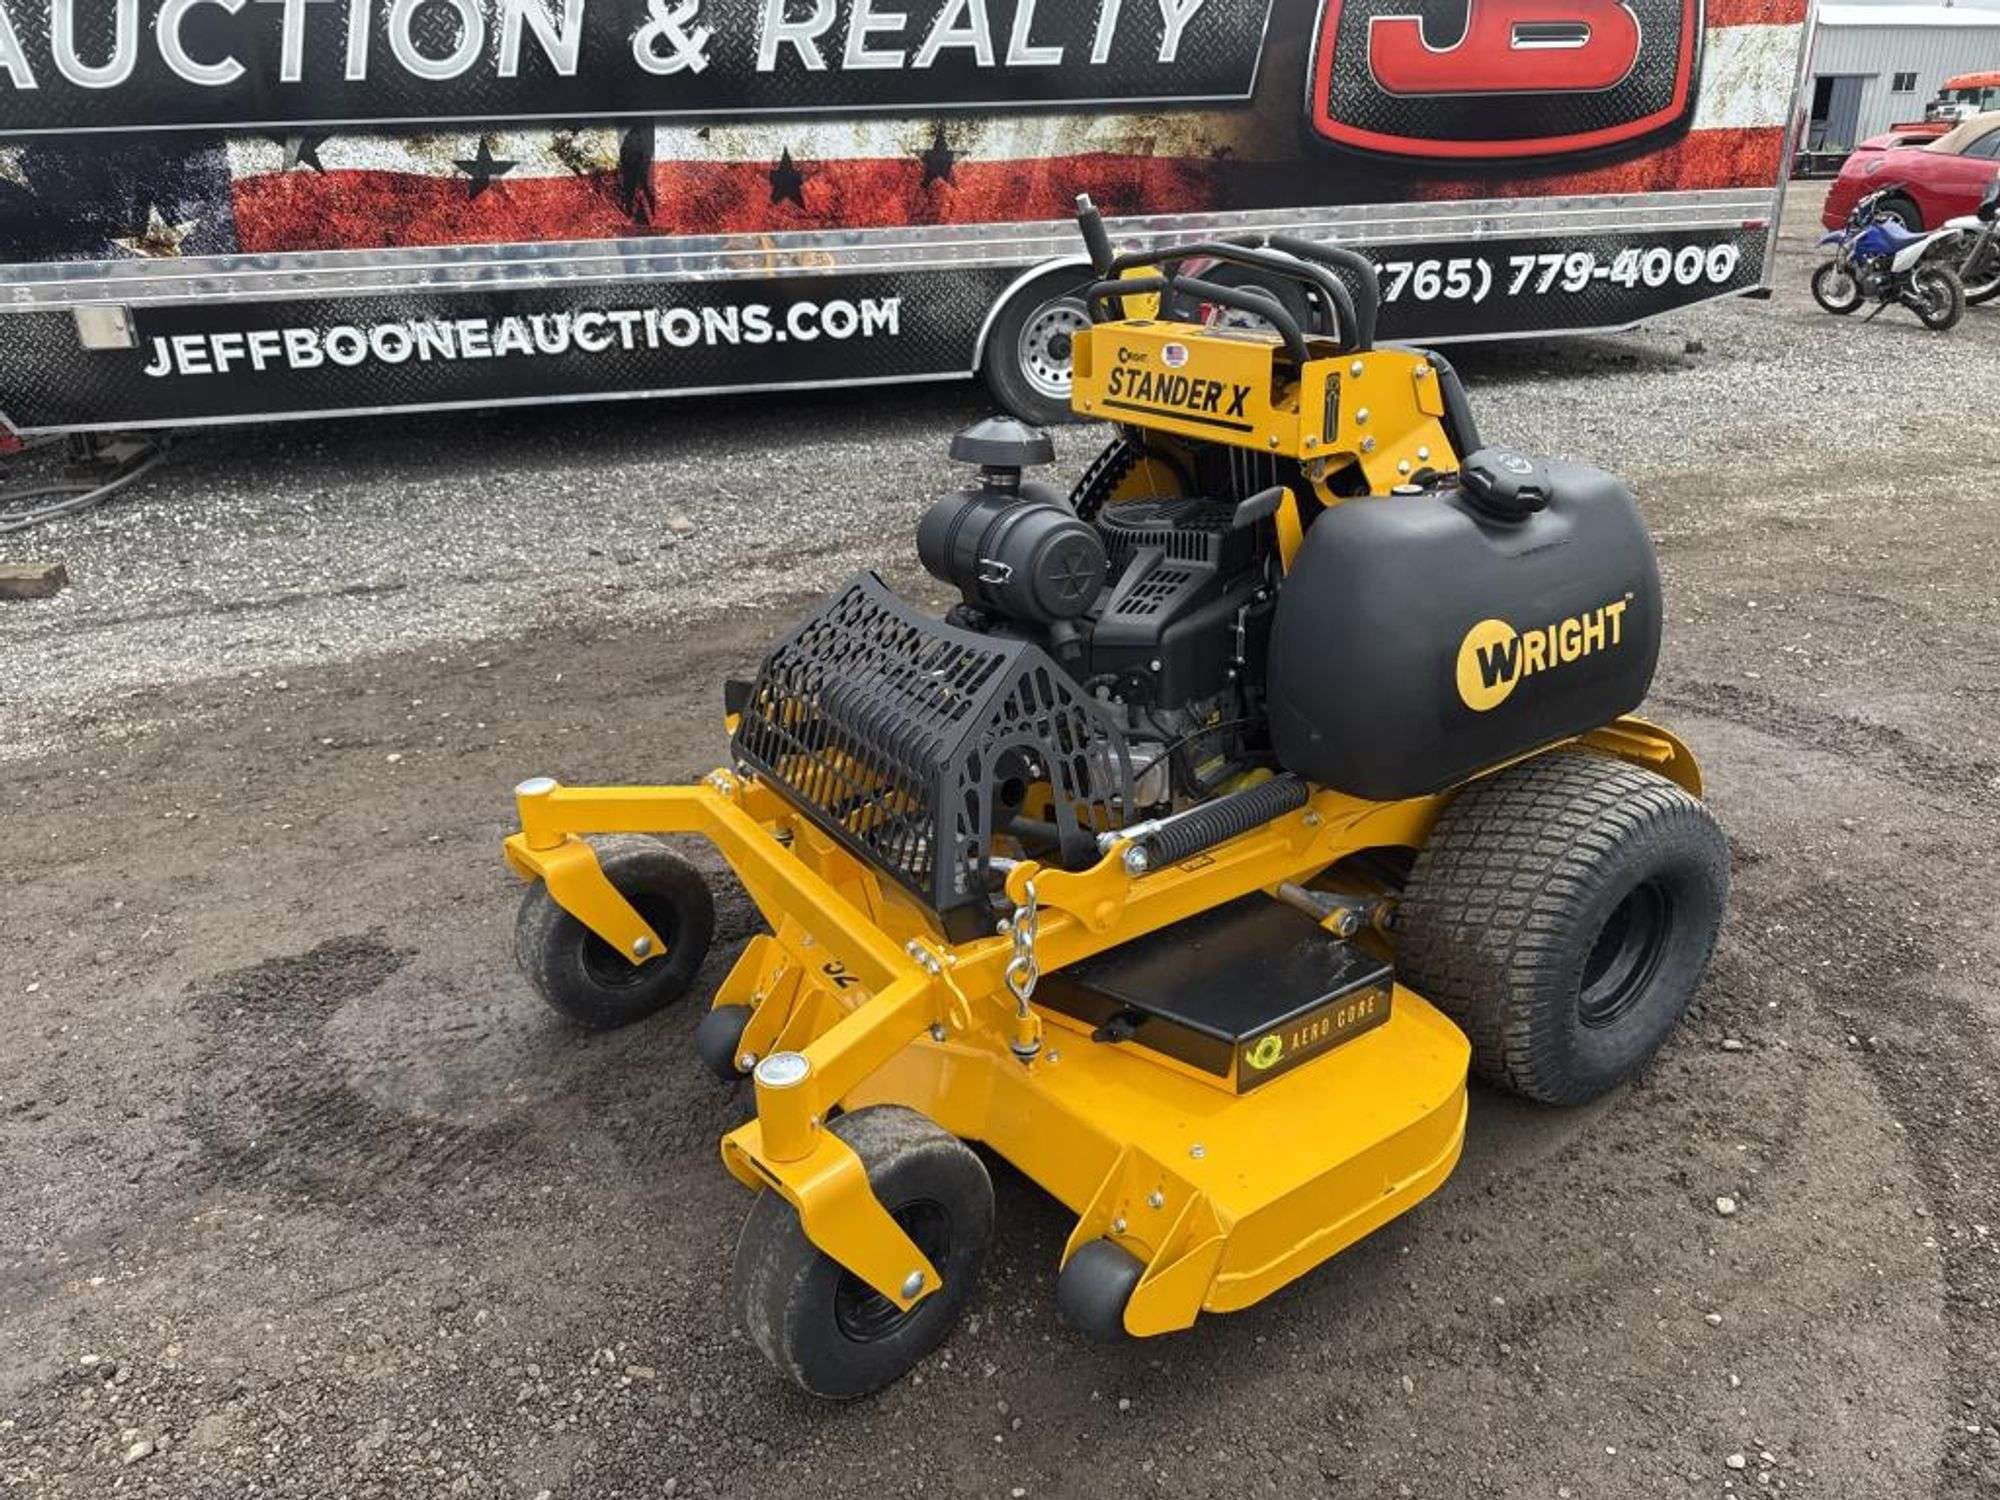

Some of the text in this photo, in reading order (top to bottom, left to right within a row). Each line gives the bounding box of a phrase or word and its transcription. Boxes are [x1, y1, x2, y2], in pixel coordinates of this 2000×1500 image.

[632, 0, 713, 75] &
[755, 0, 1203, 71] REALTY
[1374, 243, 1740, 304] 765) 779-4000
[143, 297, 901, 377] JEFFBOONEAUCTIONS.COM
[1108, 367, 1251, 417] STANDER X
[1474, 600, 1627, 689] WRIGHT
